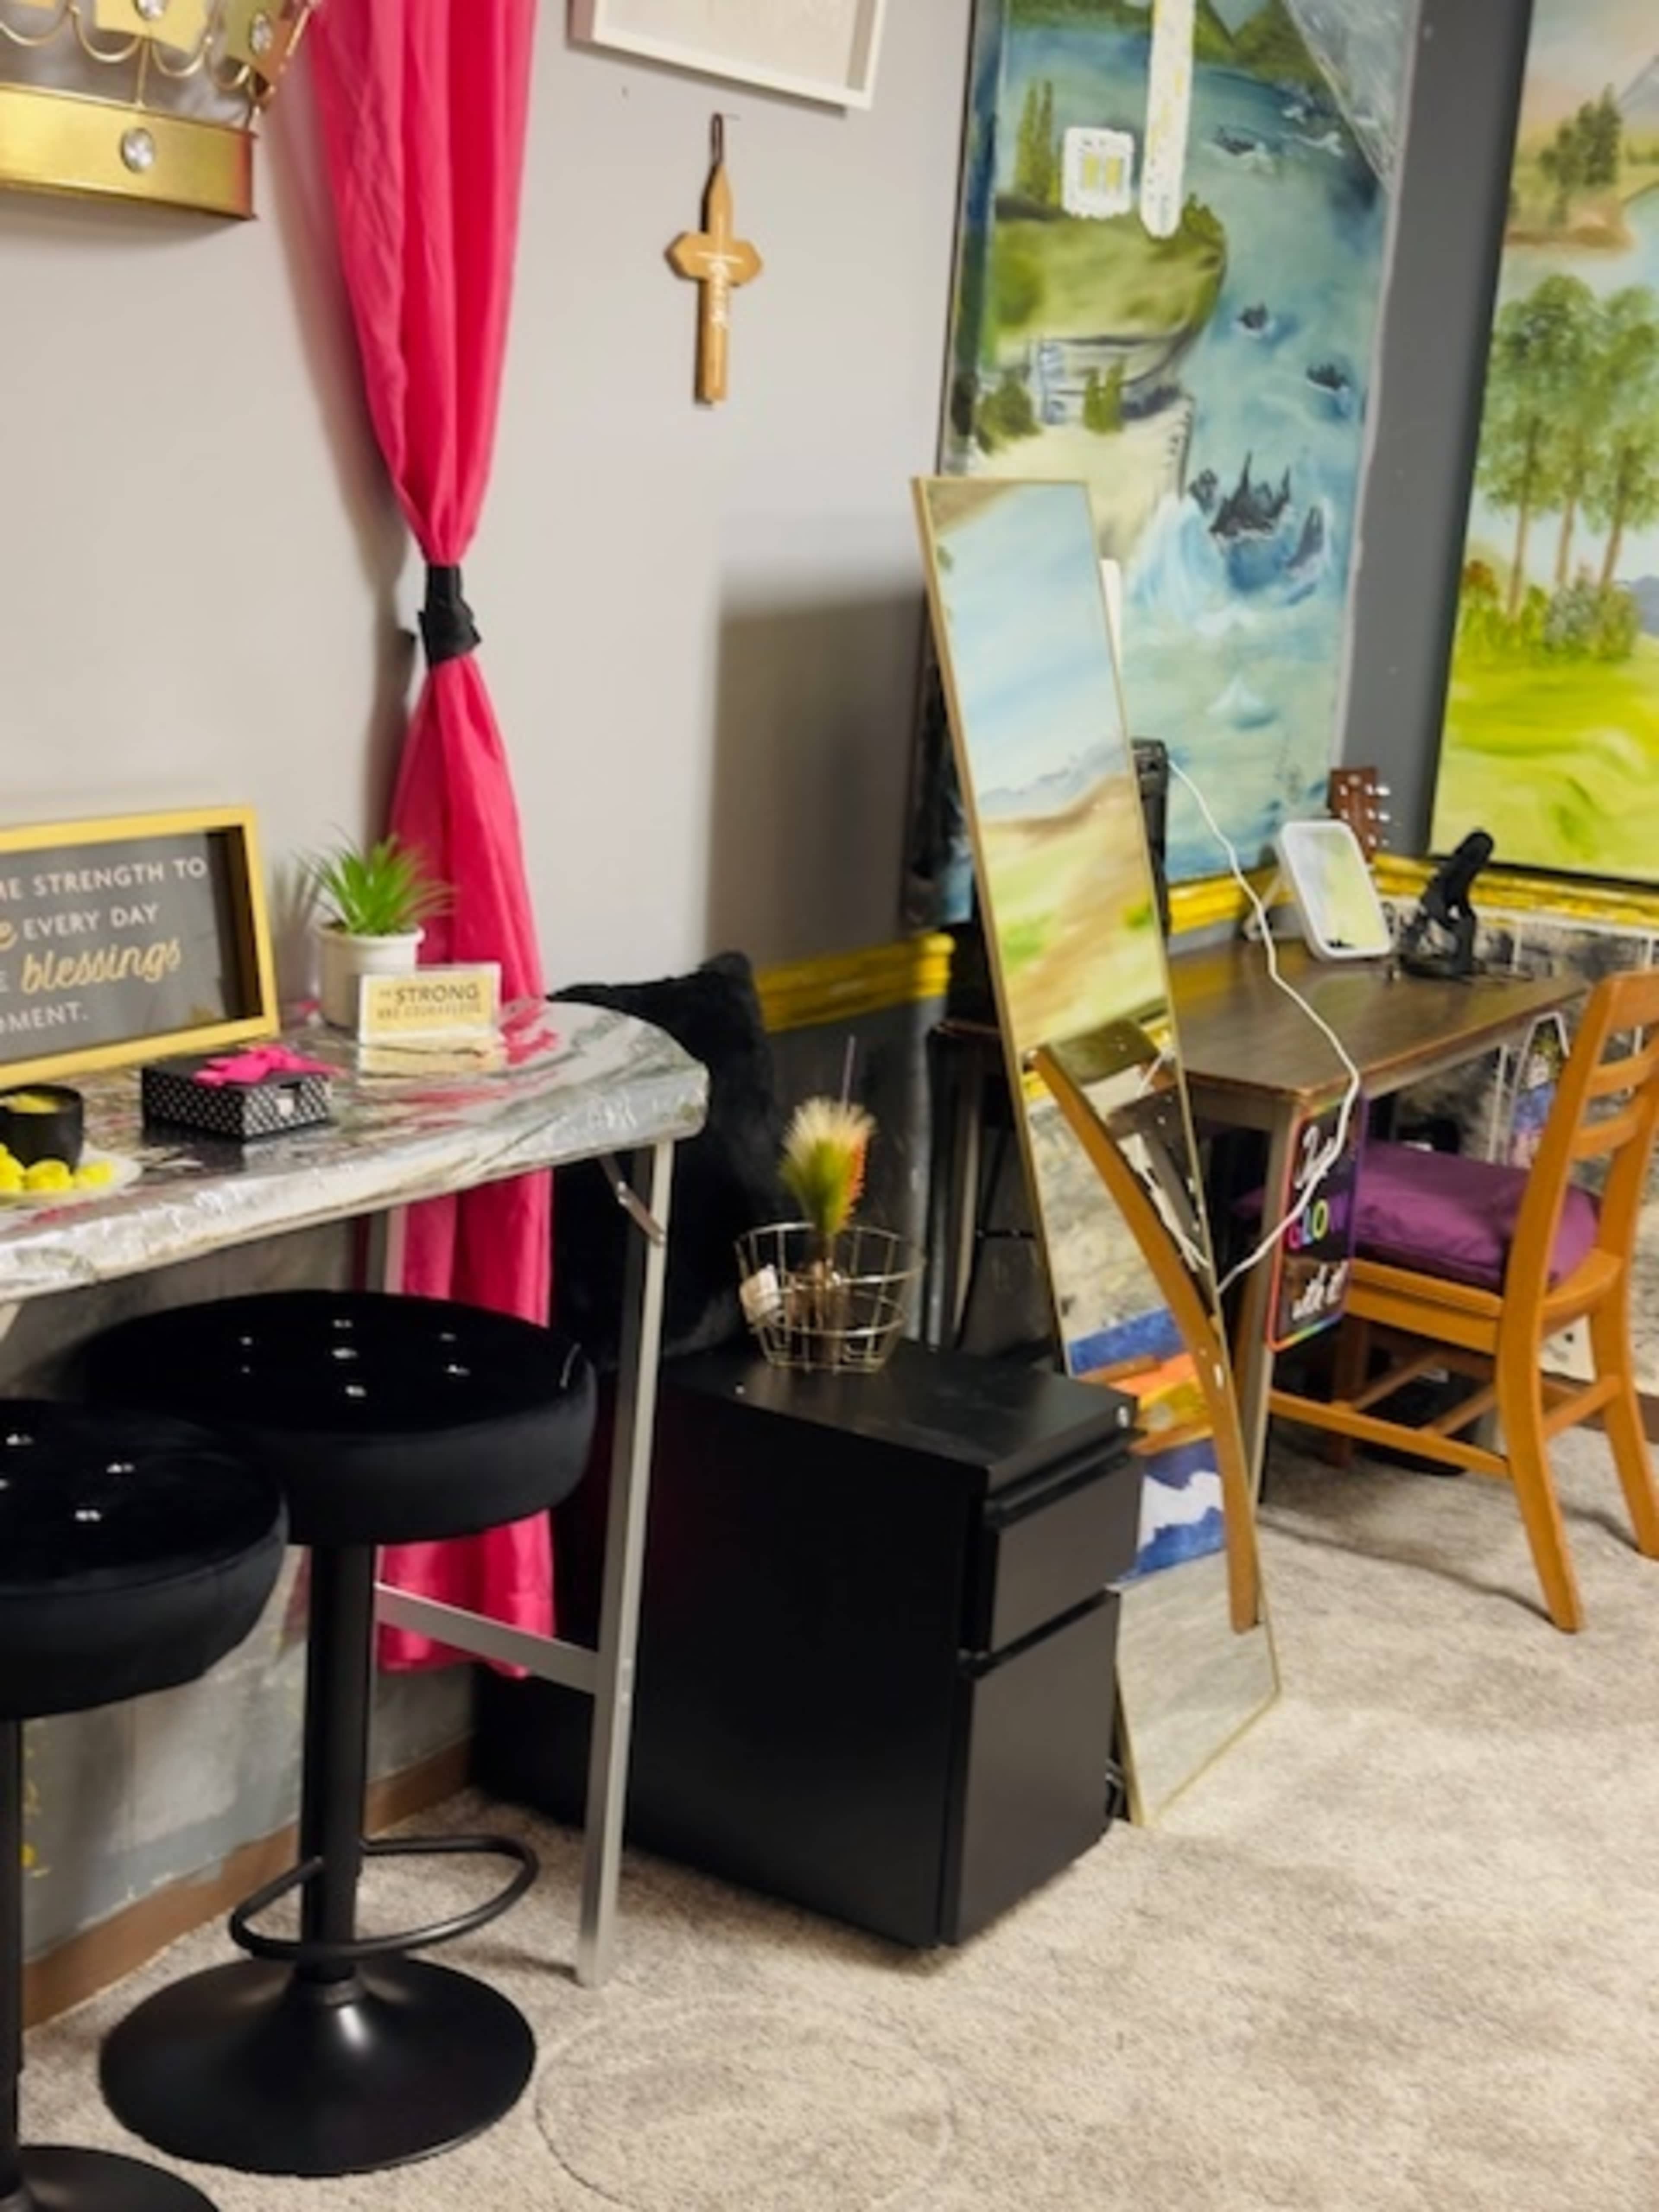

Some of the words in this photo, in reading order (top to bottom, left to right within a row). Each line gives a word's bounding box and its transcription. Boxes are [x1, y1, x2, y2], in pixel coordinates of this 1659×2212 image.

[33, 863, 164, 897] STRENGTH
[172, 857, 207, 879] TO
[23, 910, 99, 941] EVERY
[111, 904, 159, 928] DAY
[21, 938, 182, 995] blessings
[396, 982, 479, 1005] STRONG
